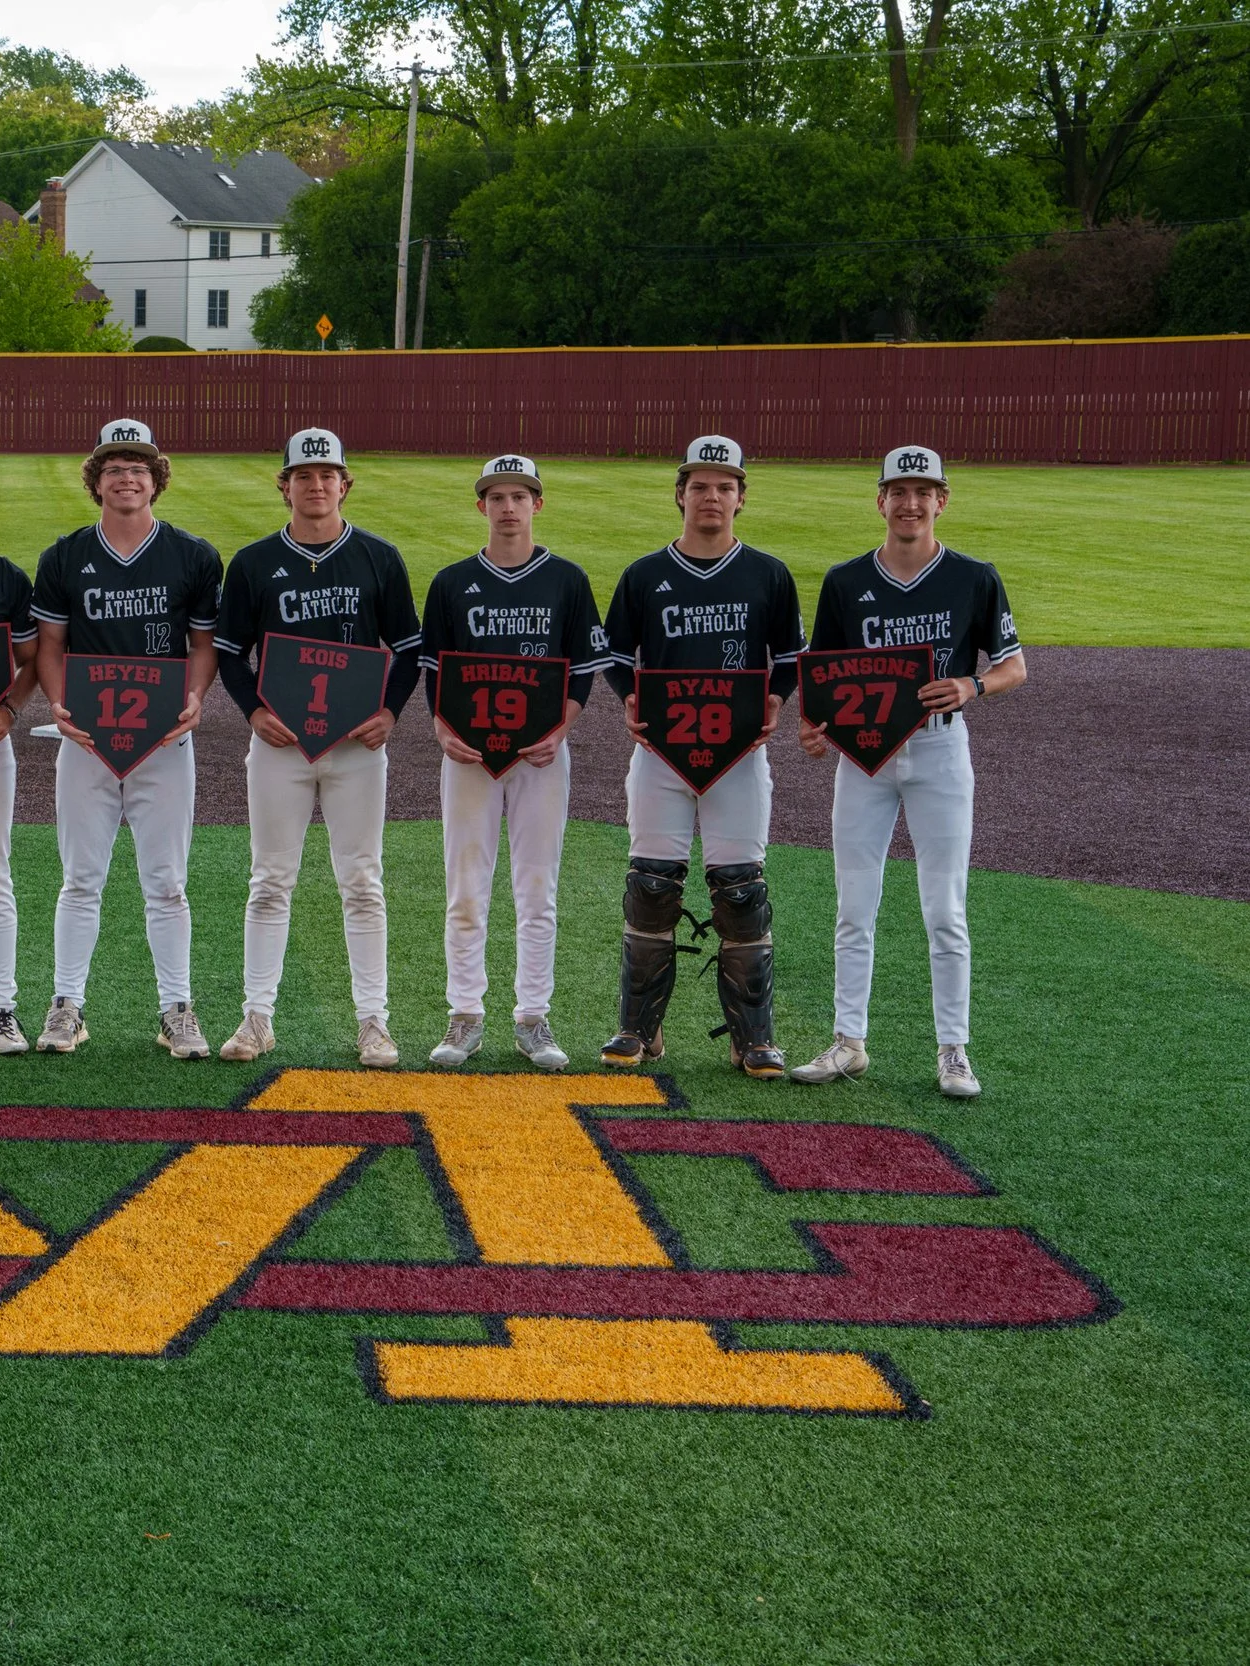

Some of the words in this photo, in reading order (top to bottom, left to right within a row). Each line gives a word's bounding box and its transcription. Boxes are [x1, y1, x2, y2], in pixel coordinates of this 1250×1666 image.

[84, 587, 168, 620] CATHOLIC
[104, 587, 167, 600] MONTINI
[683, 603, 748, 616] MONTINI
[467, 605, 550, 637] CATHOLIC
[488, 607, 551, 617] MONTINI
[662, 604, 748, 638] CATHOLIC
[883, 611, 951, 627] MONTINI
[144, 622, 171, 655] 12
[862, 615, 951, 648] CATHOLIC
[88, 663, 162, 685] HEYER
[299, 647, 349, 670] KOIS
[811, 657, 921, 685] SANSONE
[461, 664, 540, 687] HRIBAL
[666, 678, 734, 698] RYAN
[97, 687, 149, 729] 12
[307, 673, 329, 714] 1
[470, 687, 528, 730] 19
[833, 682, 898, 726] 27
[666, 703, 732, 744] 28
